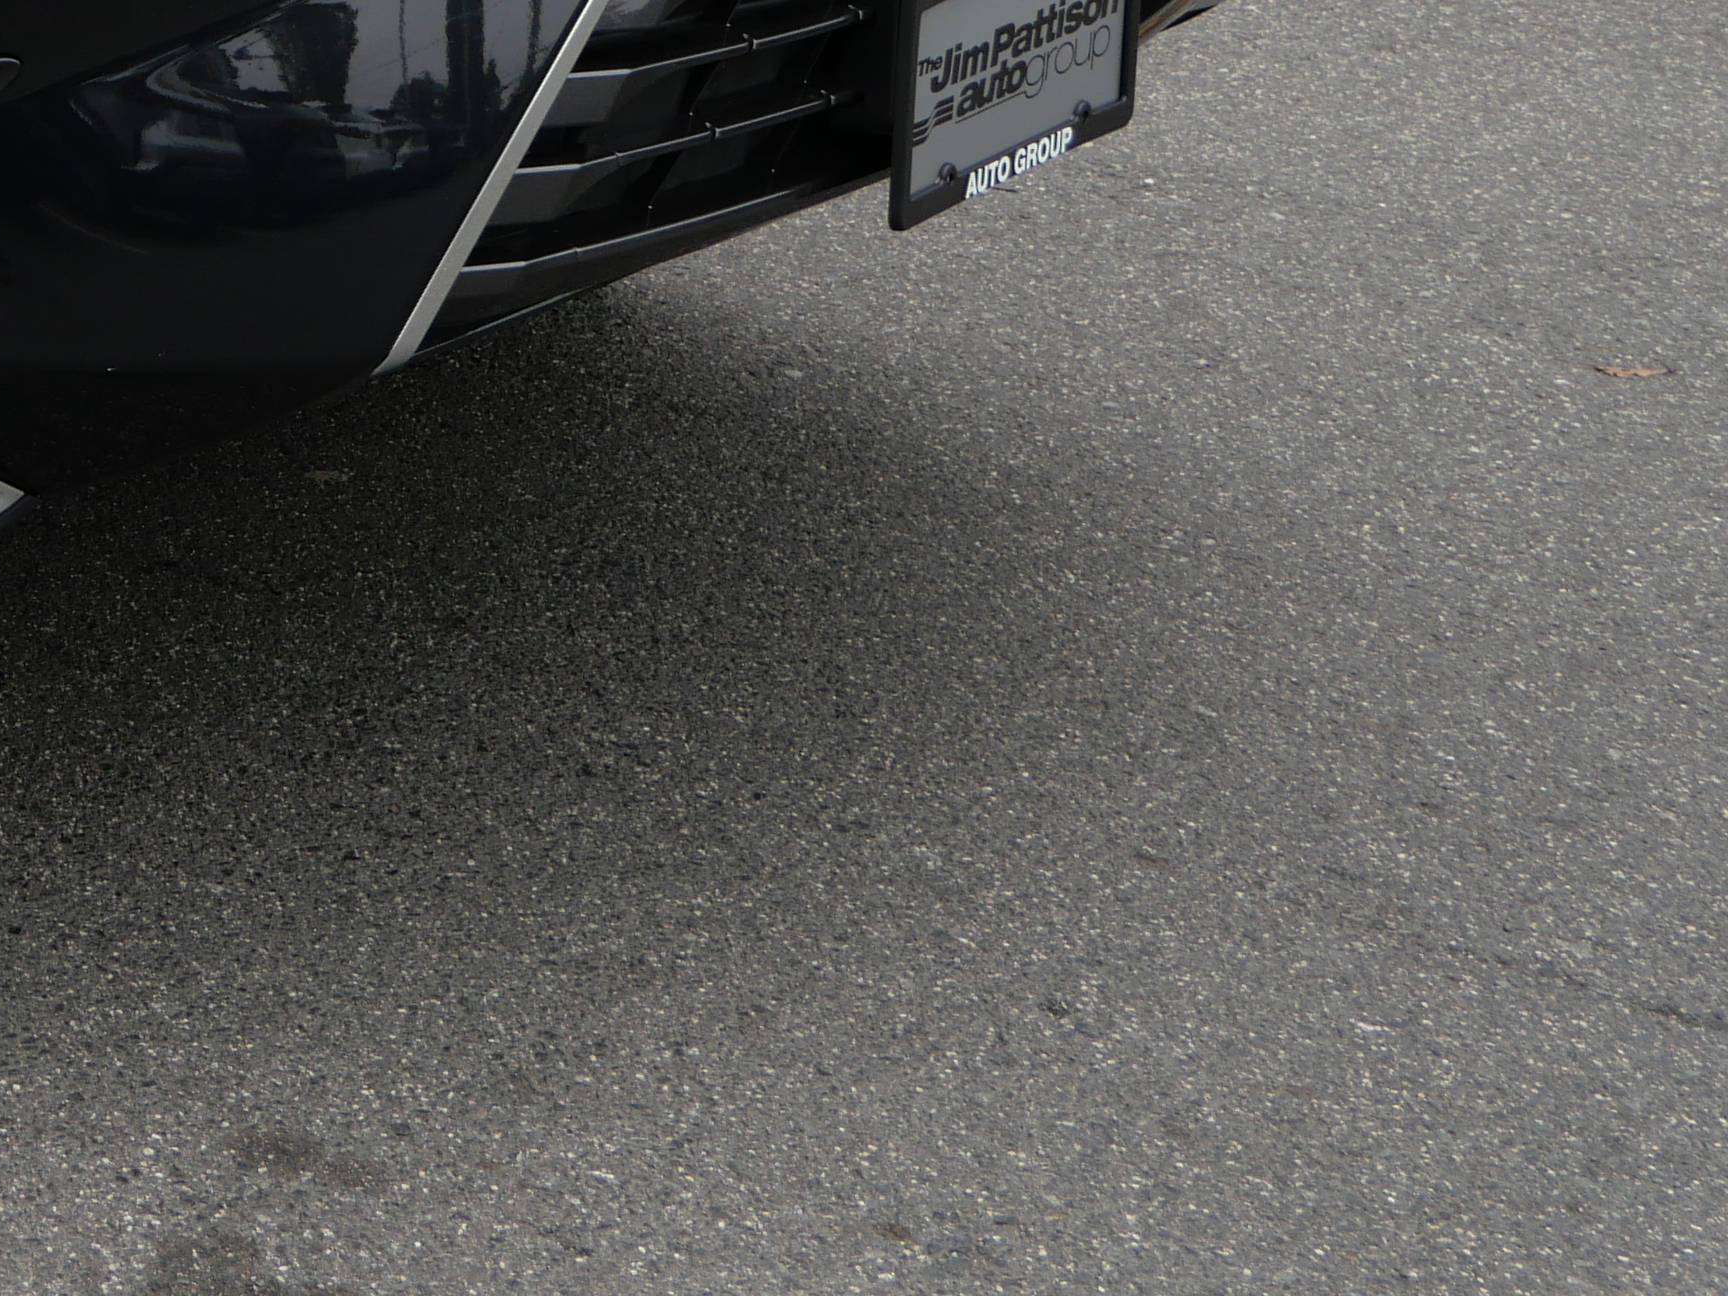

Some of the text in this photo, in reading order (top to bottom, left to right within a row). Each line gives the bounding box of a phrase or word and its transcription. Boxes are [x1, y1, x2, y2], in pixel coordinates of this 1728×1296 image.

[918, 52, 943, 79] The
[930, 39, 990, 93] Jim
[965, 126, 1074, 199] AUTO GROUP
